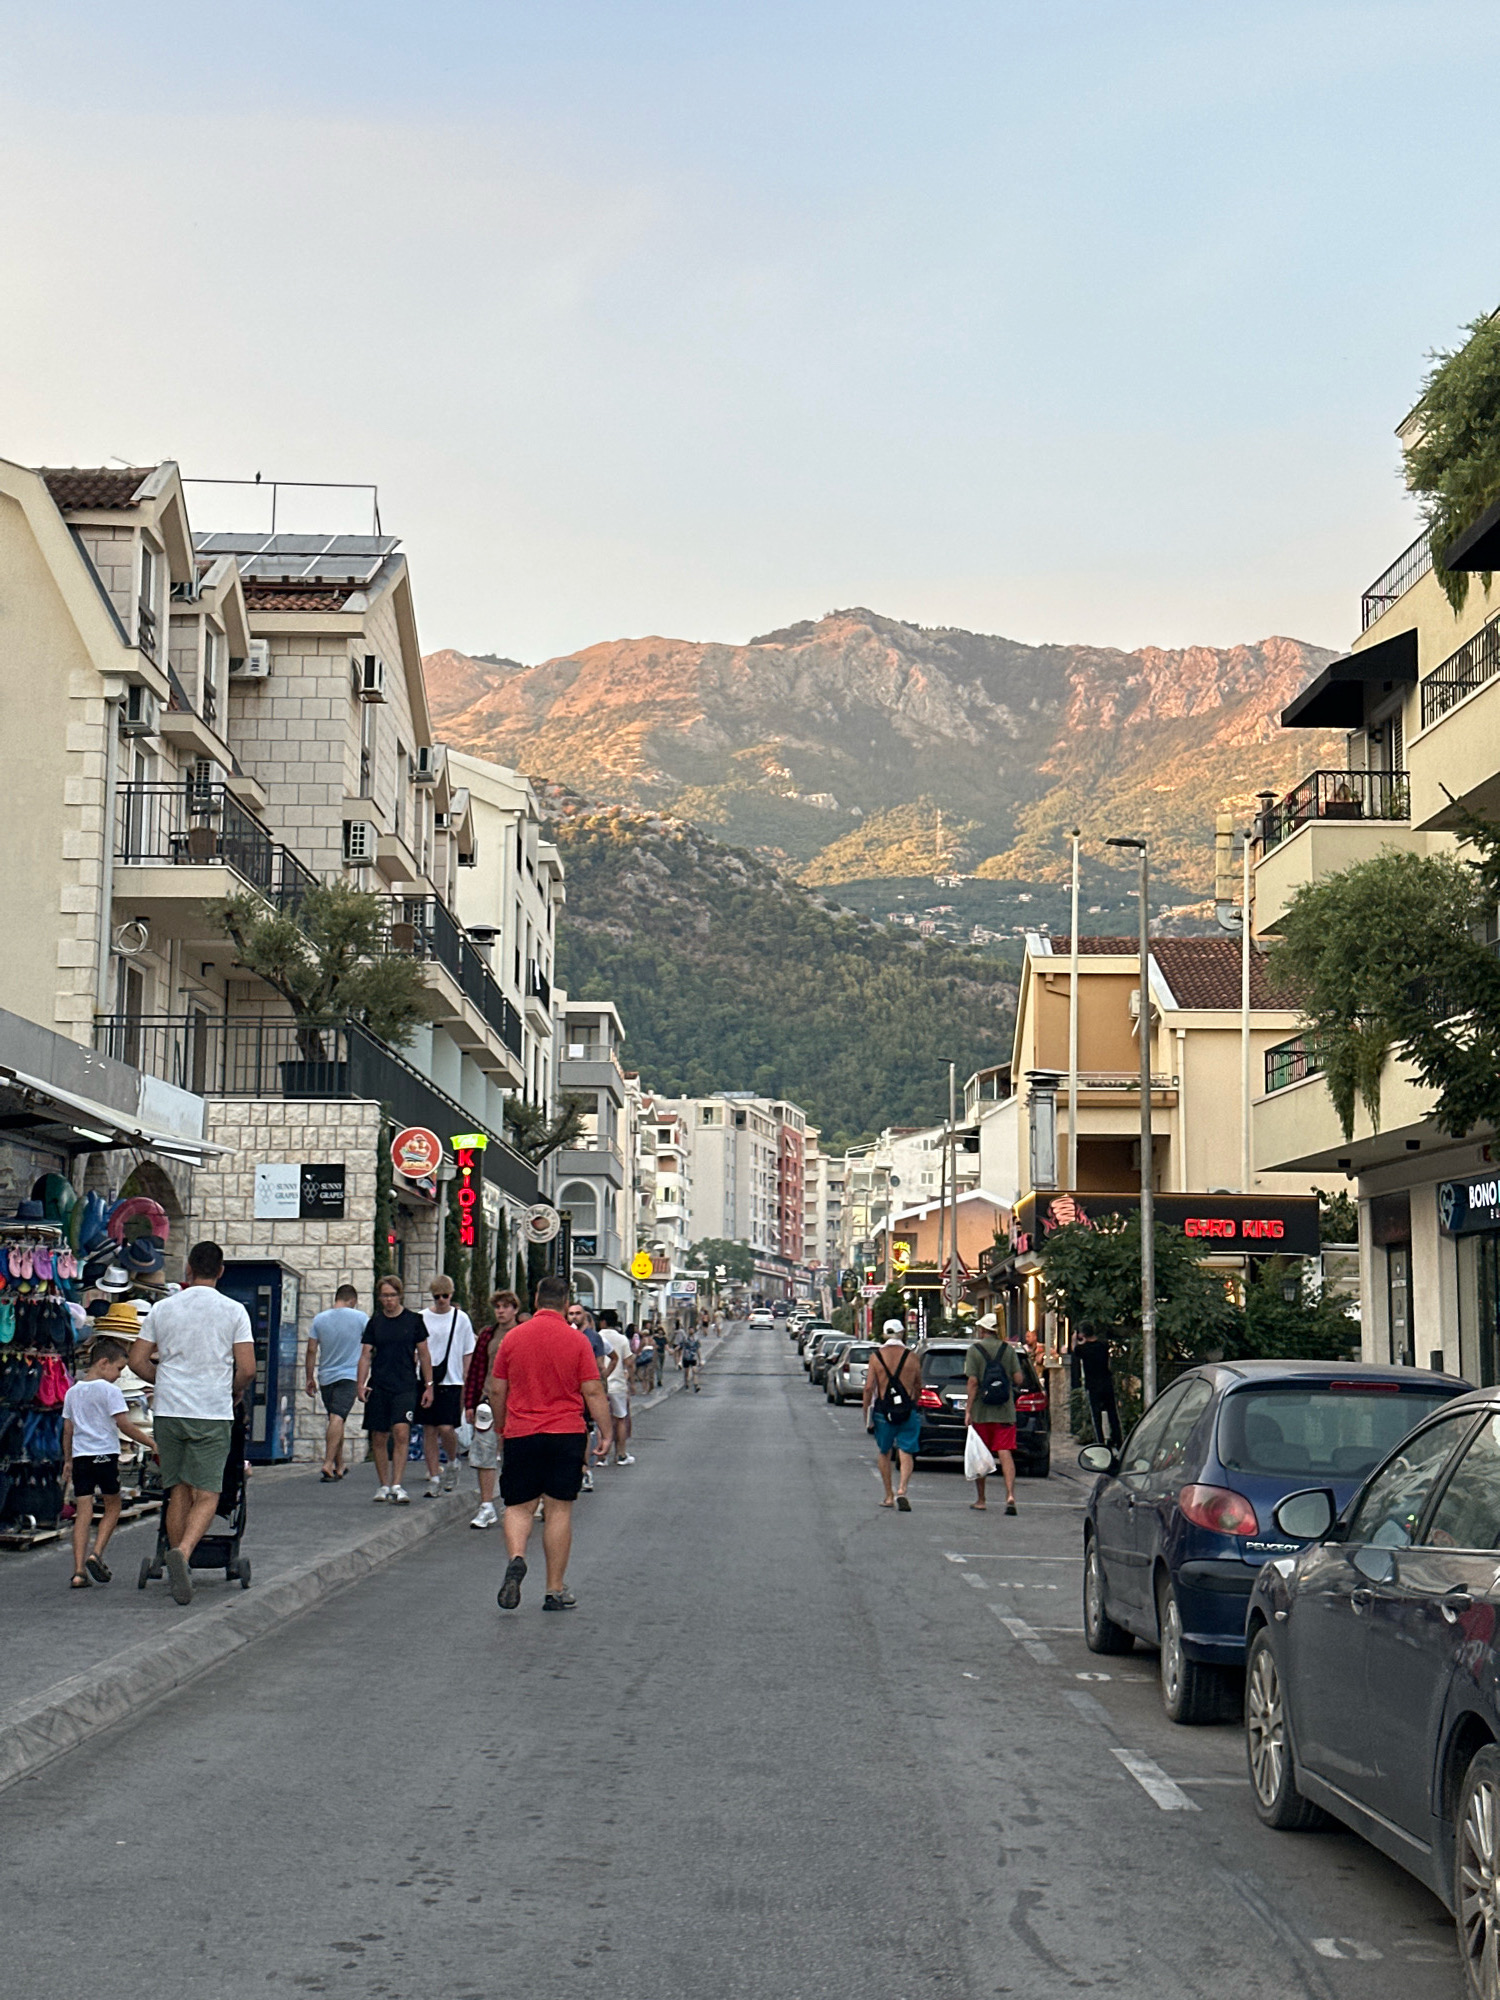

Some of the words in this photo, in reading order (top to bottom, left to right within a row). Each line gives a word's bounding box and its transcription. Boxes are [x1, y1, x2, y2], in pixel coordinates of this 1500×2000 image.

[319, 1191, 344, 1199] GRAPES
[1469, 1180, 1500, 1208] BONO
[1185, 1218, 1236, 1238] GYRO
[1242, 1219, 1284, 1238] KING
[1246, 1541, 1300, 1553] PEUGEOT
